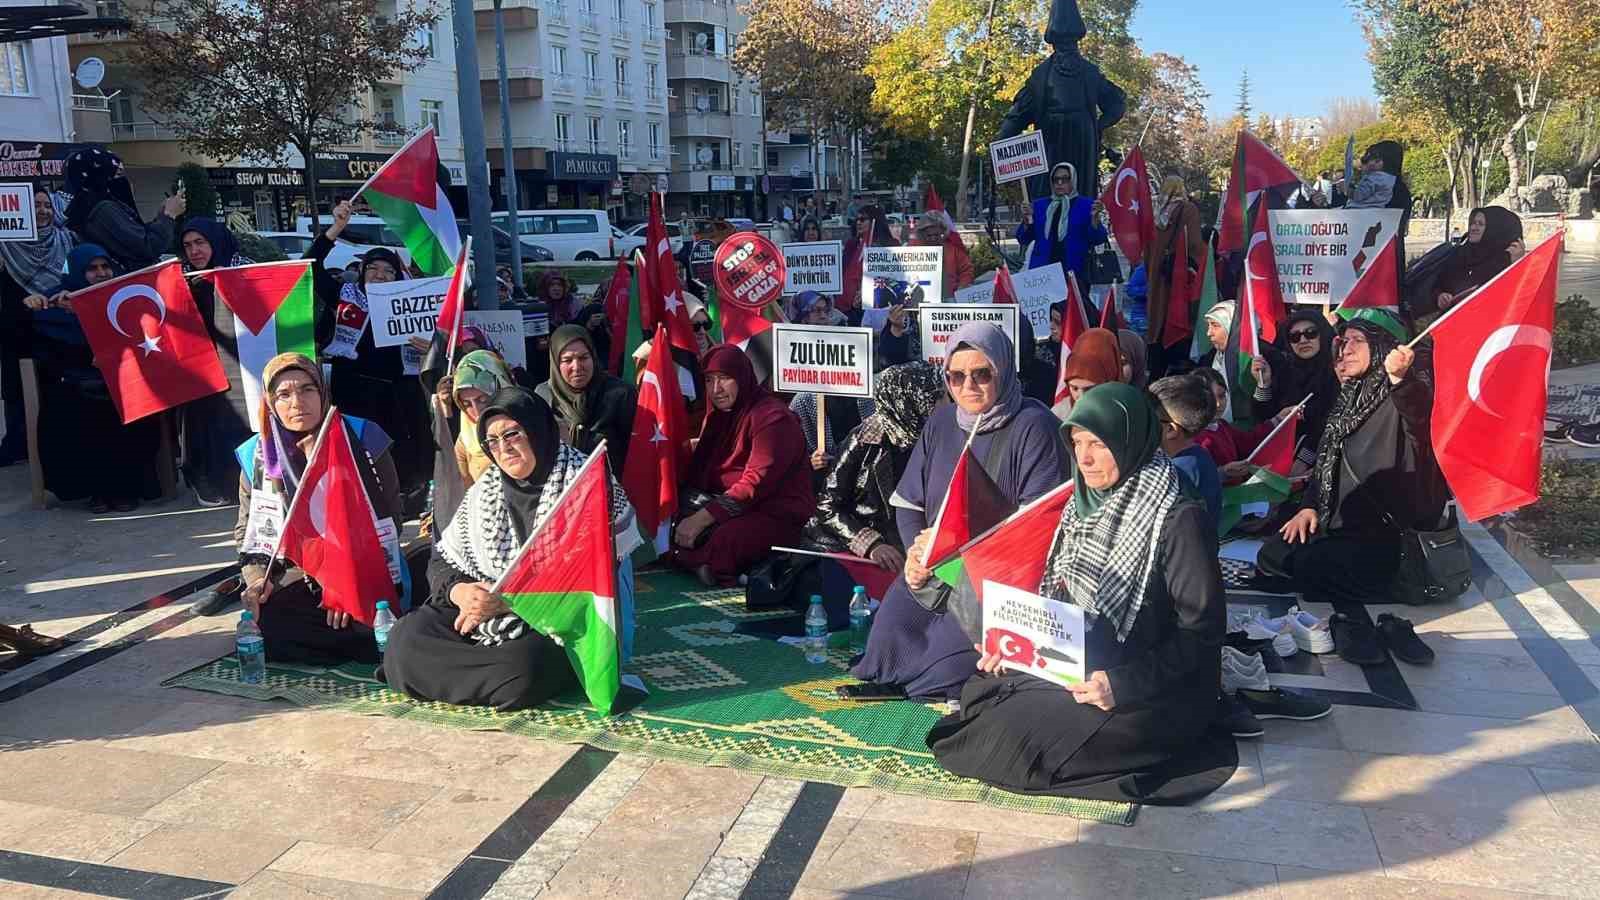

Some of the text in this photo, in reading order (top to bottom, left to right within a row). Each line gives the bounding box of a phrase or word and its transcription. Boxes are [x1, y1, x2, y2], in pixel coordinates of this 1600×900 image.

[236, 172, 264, 185] SHOW
[0, 194, 20, 212] IN
[1276, 223, 1303, 237] ORTA
[722, 241, 755, 271] STOP
[1305, 241, 1328, 257] DİYE
[1329, 242, 1348, 257] BİR
[786, 253, 809, 268] DÜNYA
[793, 269, 833, 285] BÜYÜKTÜR.
[1278, 263, 1314, 276] EVLETE
[733, 259, 777, 299] KILLING OF
[747, 275, 779, 302] GAZA
[931, 311, 1004, 321] SUSKUN İSLAM
[789, 338, 857, 367] ZULÜMLE
[782, 367, 864, 387] PAYİDAR OLUNMAZ.
